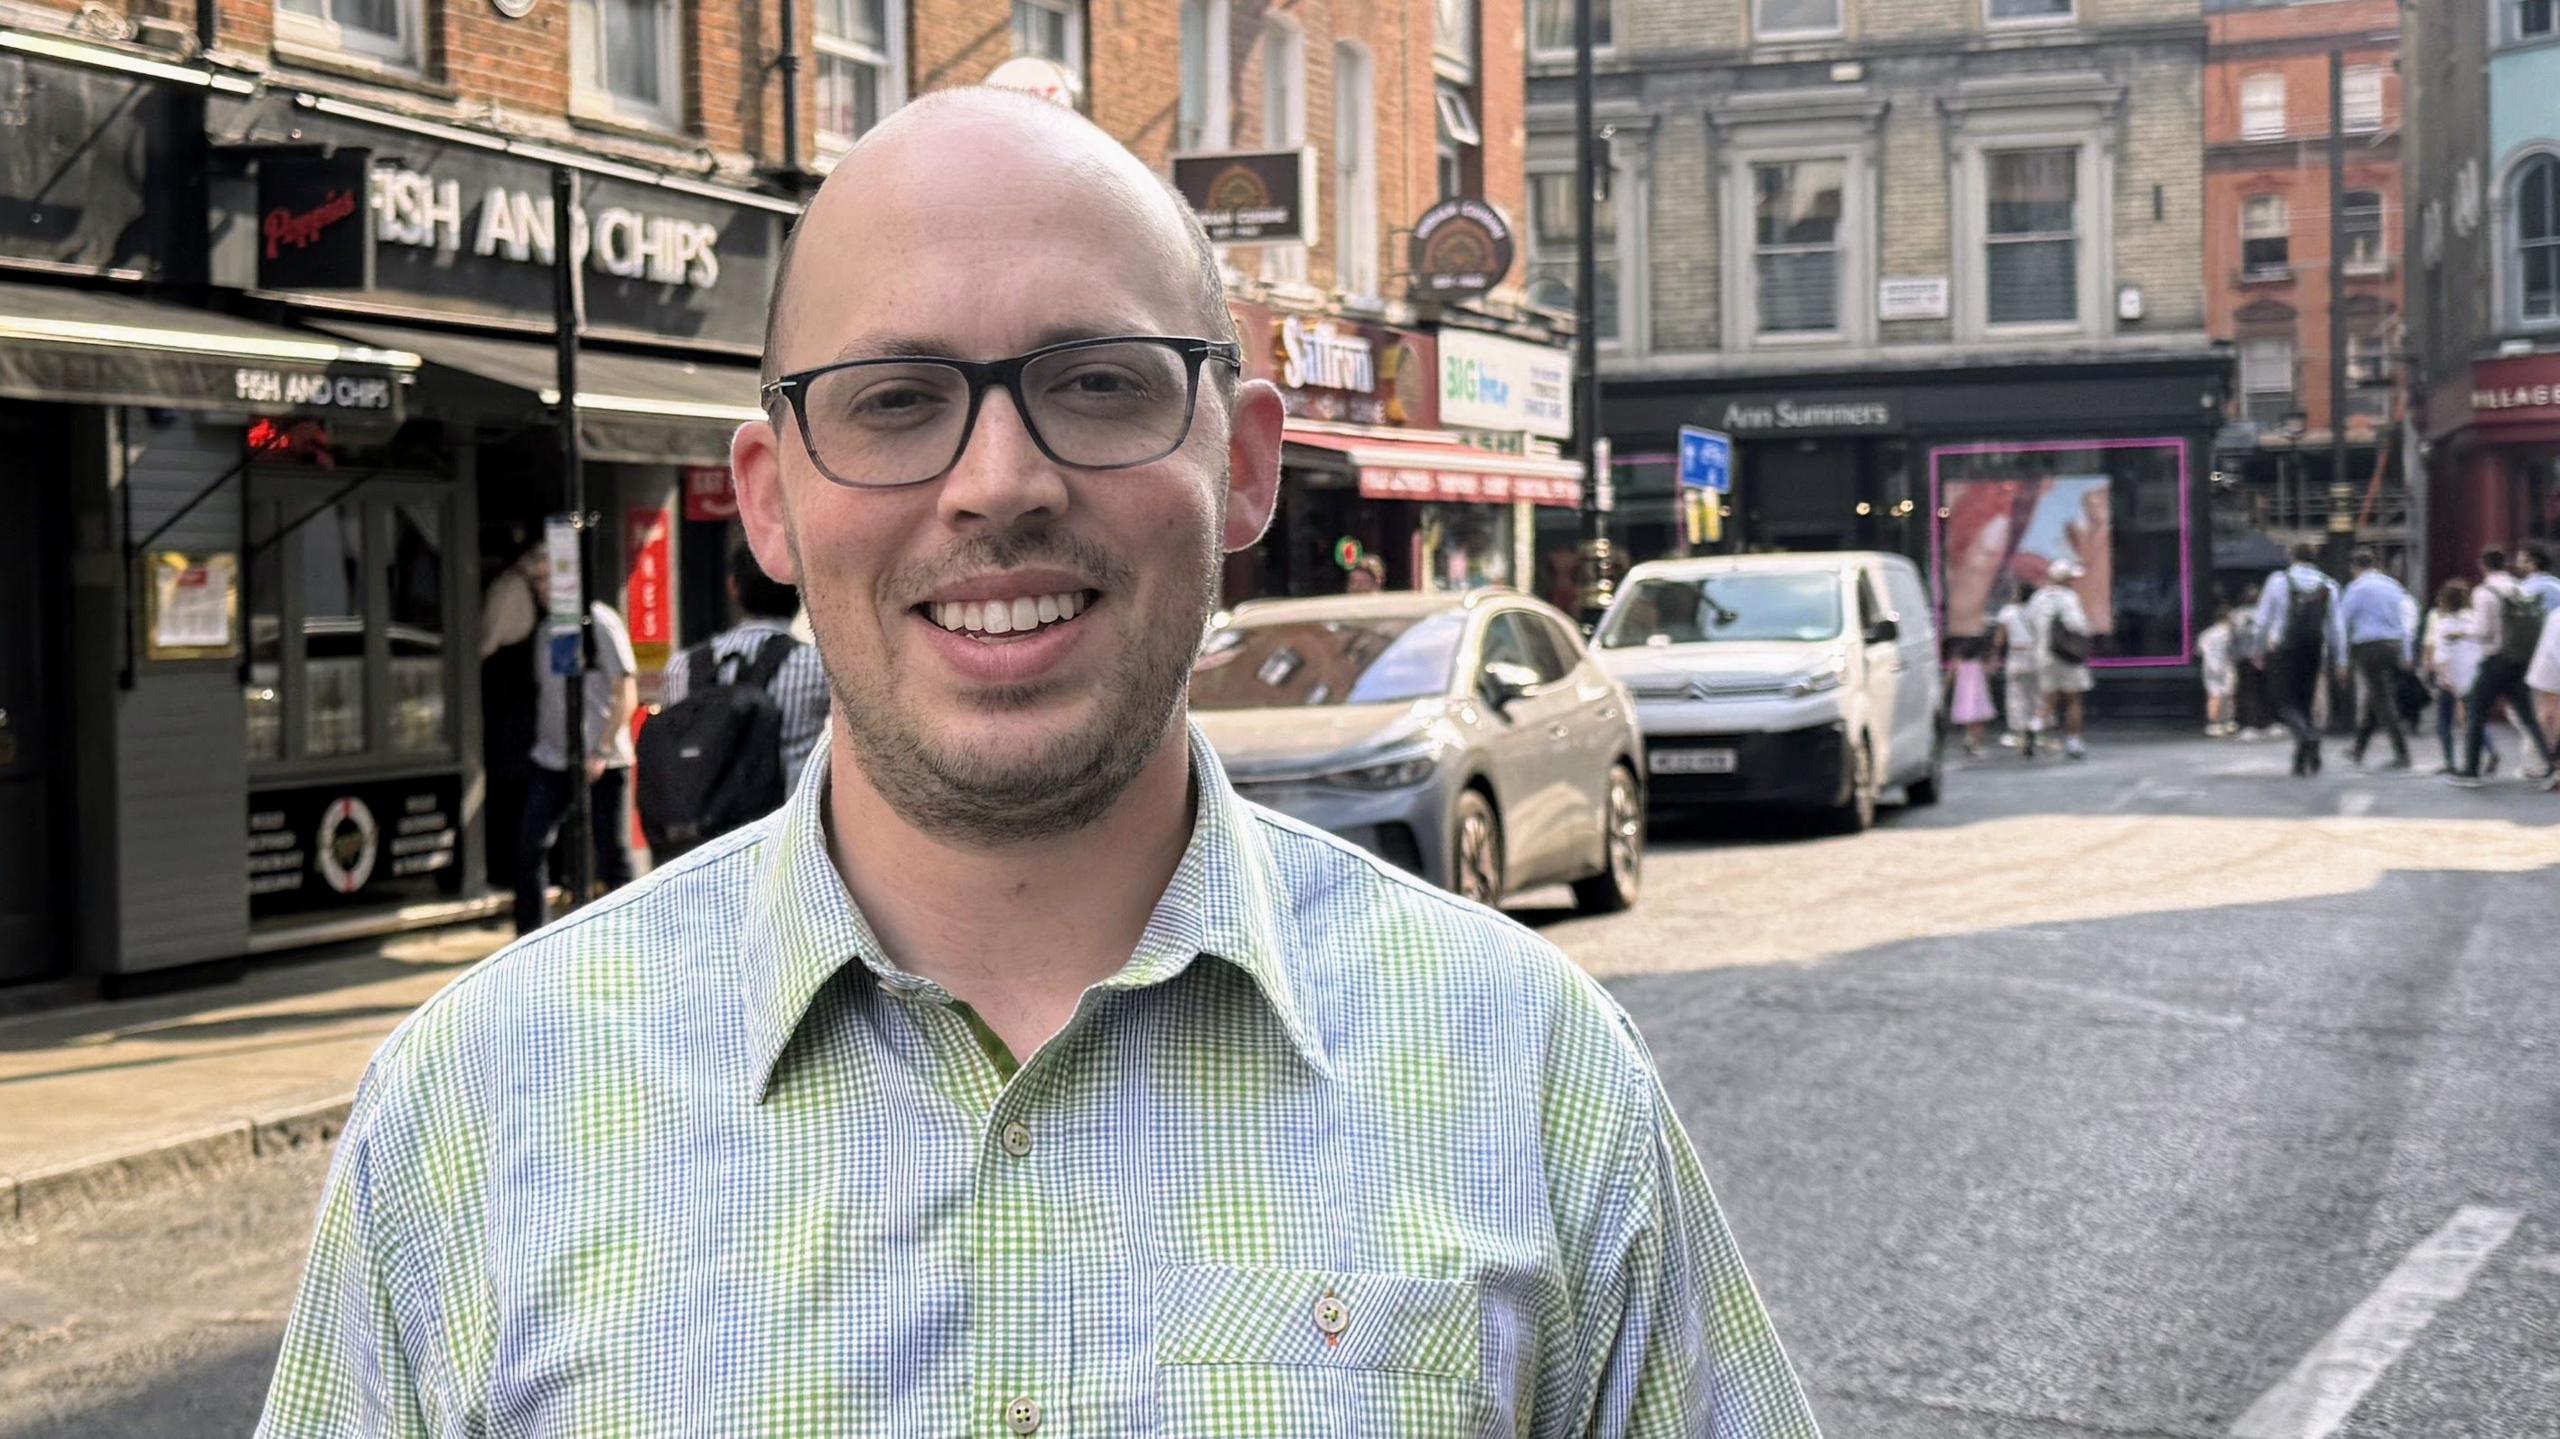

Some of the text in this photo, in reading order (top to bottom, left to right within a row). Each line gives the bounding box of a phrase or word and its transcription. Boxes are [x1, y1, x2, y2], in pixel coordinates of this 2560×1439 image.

[593, 207, 719, 288] CHIPS
[235, 368, 390, 409] FISH AND CHIPS
[1722, 399, 1889, 429] Ann Summers
